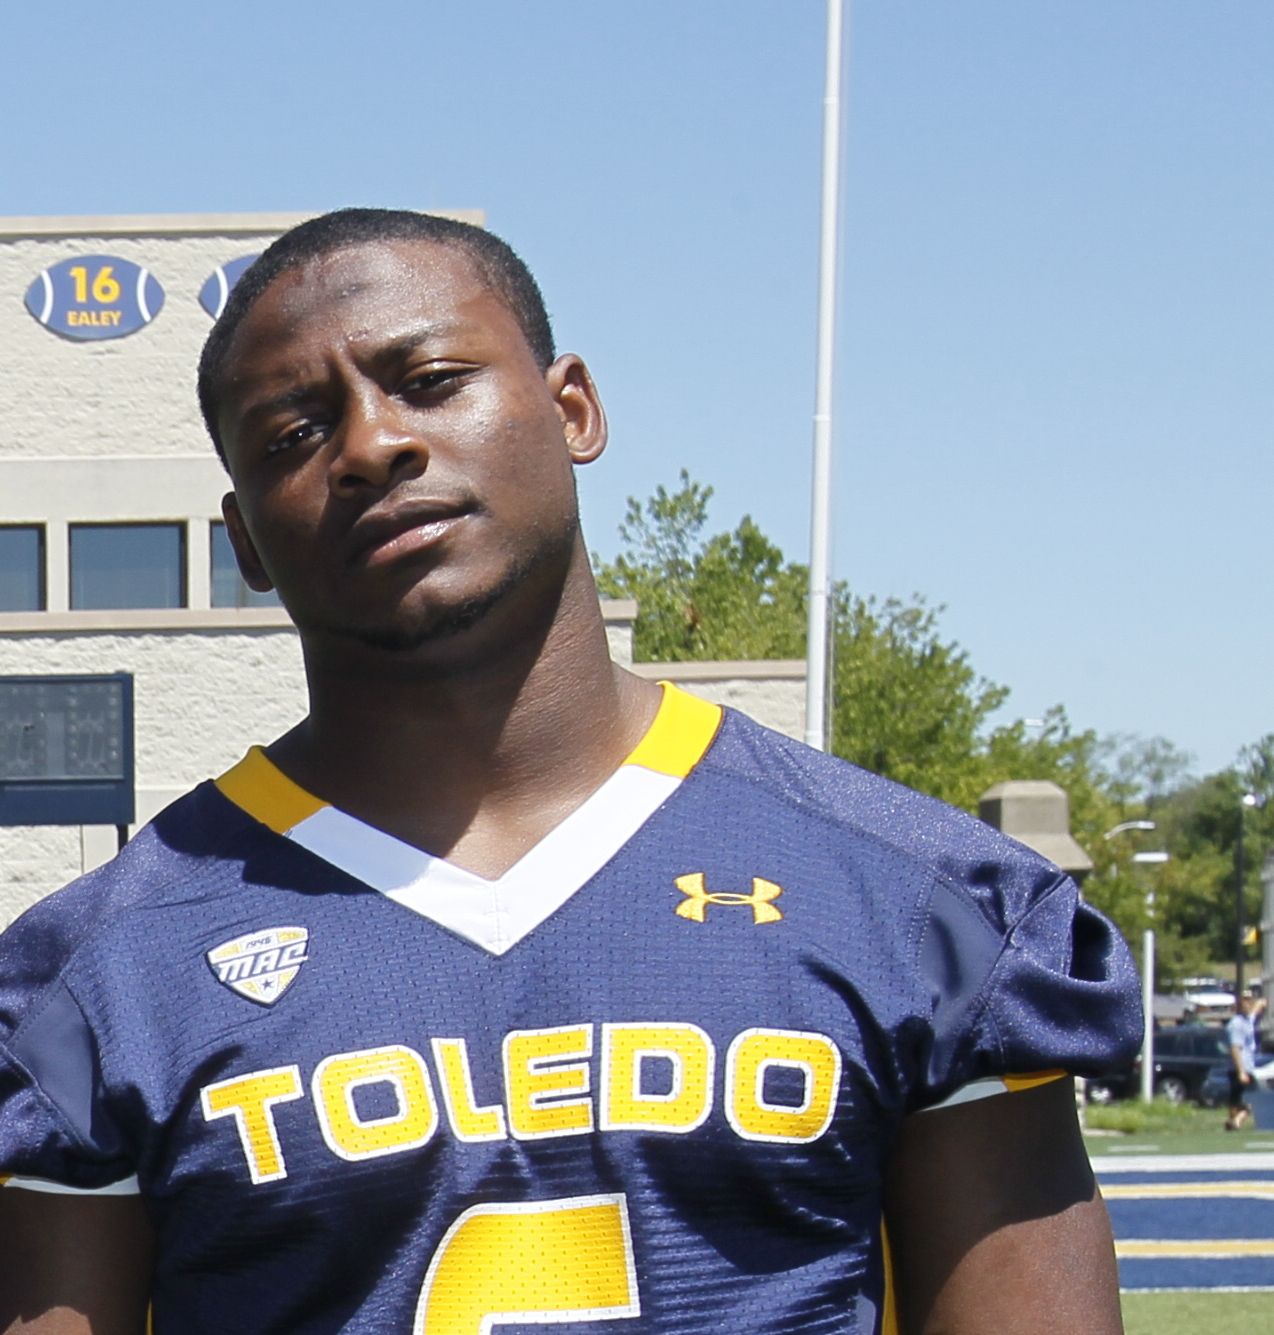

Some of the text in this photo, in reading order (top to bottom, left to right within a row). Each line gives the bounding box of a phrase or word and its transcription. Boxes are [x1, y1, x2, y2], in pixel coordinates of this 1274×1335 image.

[69, 266, 121, 303] 16
[67, 310, 122, 326] EALEY
[218, 941, 308, 982] MAC
[200, 1023, 842, 1185] TOLEDO
